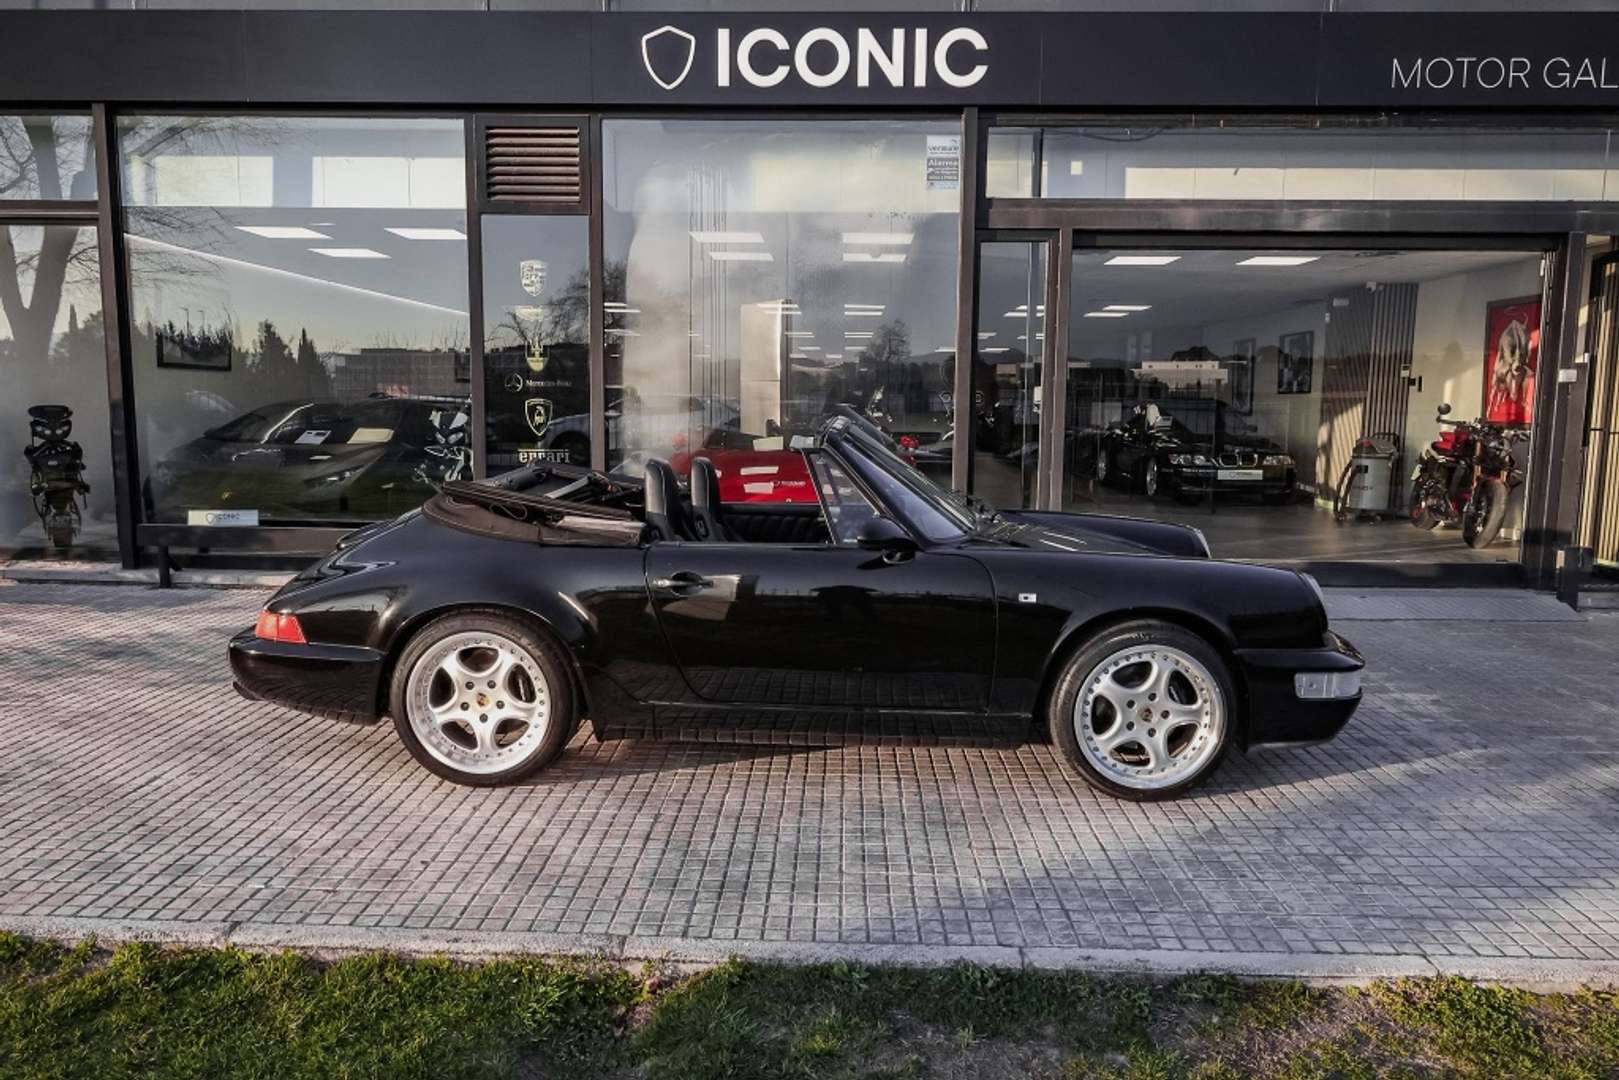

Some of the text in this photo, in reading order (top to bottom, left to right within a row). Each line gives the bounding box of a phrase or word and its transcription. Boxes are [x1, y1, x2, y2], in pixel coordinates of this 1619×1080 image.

[717, 27, 989, 88] ICONIC
[1391, 57, 1619, 89] MOTOR GAL
